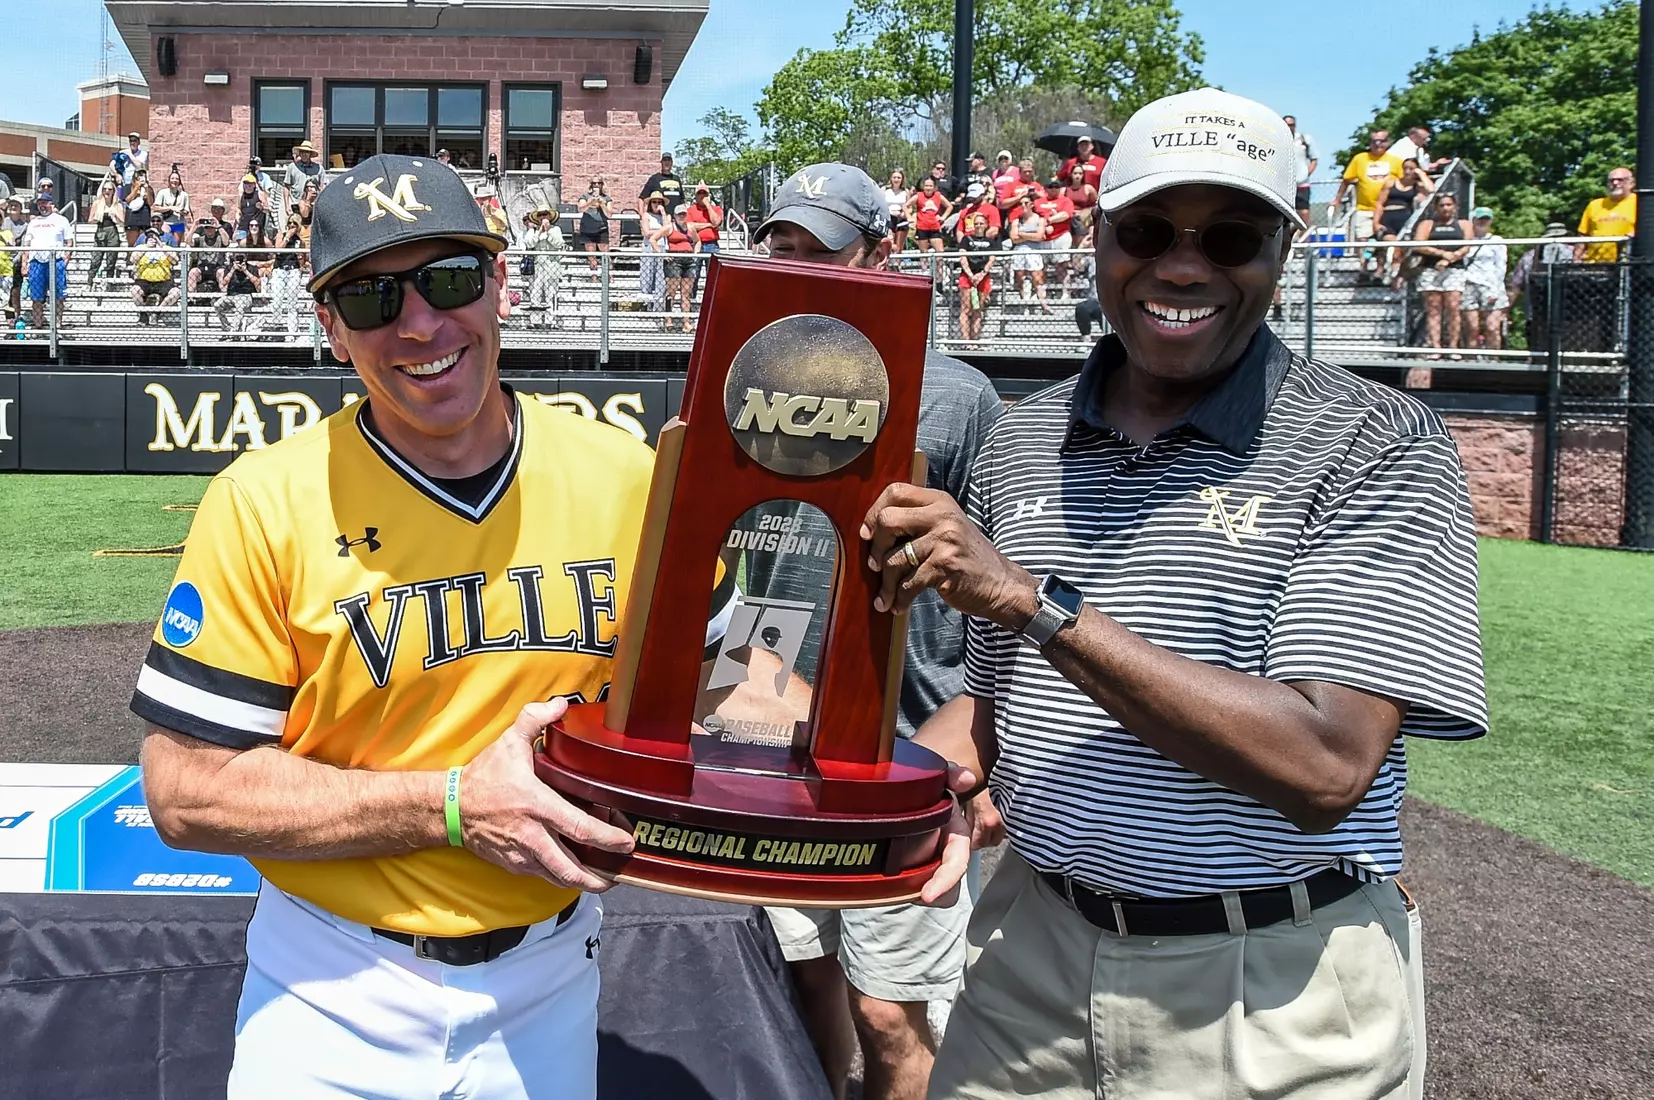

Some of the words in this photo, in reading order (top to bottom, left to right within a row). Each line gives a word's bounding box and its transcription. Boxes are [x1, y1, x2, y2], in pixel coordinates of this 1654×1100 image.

[1185, 116, 1197, 124] IT
[1199, 115, 1236, 127] TAKES
[1238, 121, 1246, 129] A
[1151, 131, 1219, 148] VILLE
[732, 387, 881, 443] NCAA
[726, 529, 812, 556] DIVISION
[814, 538, 831, 557] II
[165, 606, 199, 637] NCAA
[334, 558, 619, 688] VILLE
[720, 732, 792, 749] CHAMPIONSHIP
[723, 718, 792, 738] BASEBALL
[634, 820, 746, 860] REGIONAL
[752, 839, 877, 866] CHAMPION
